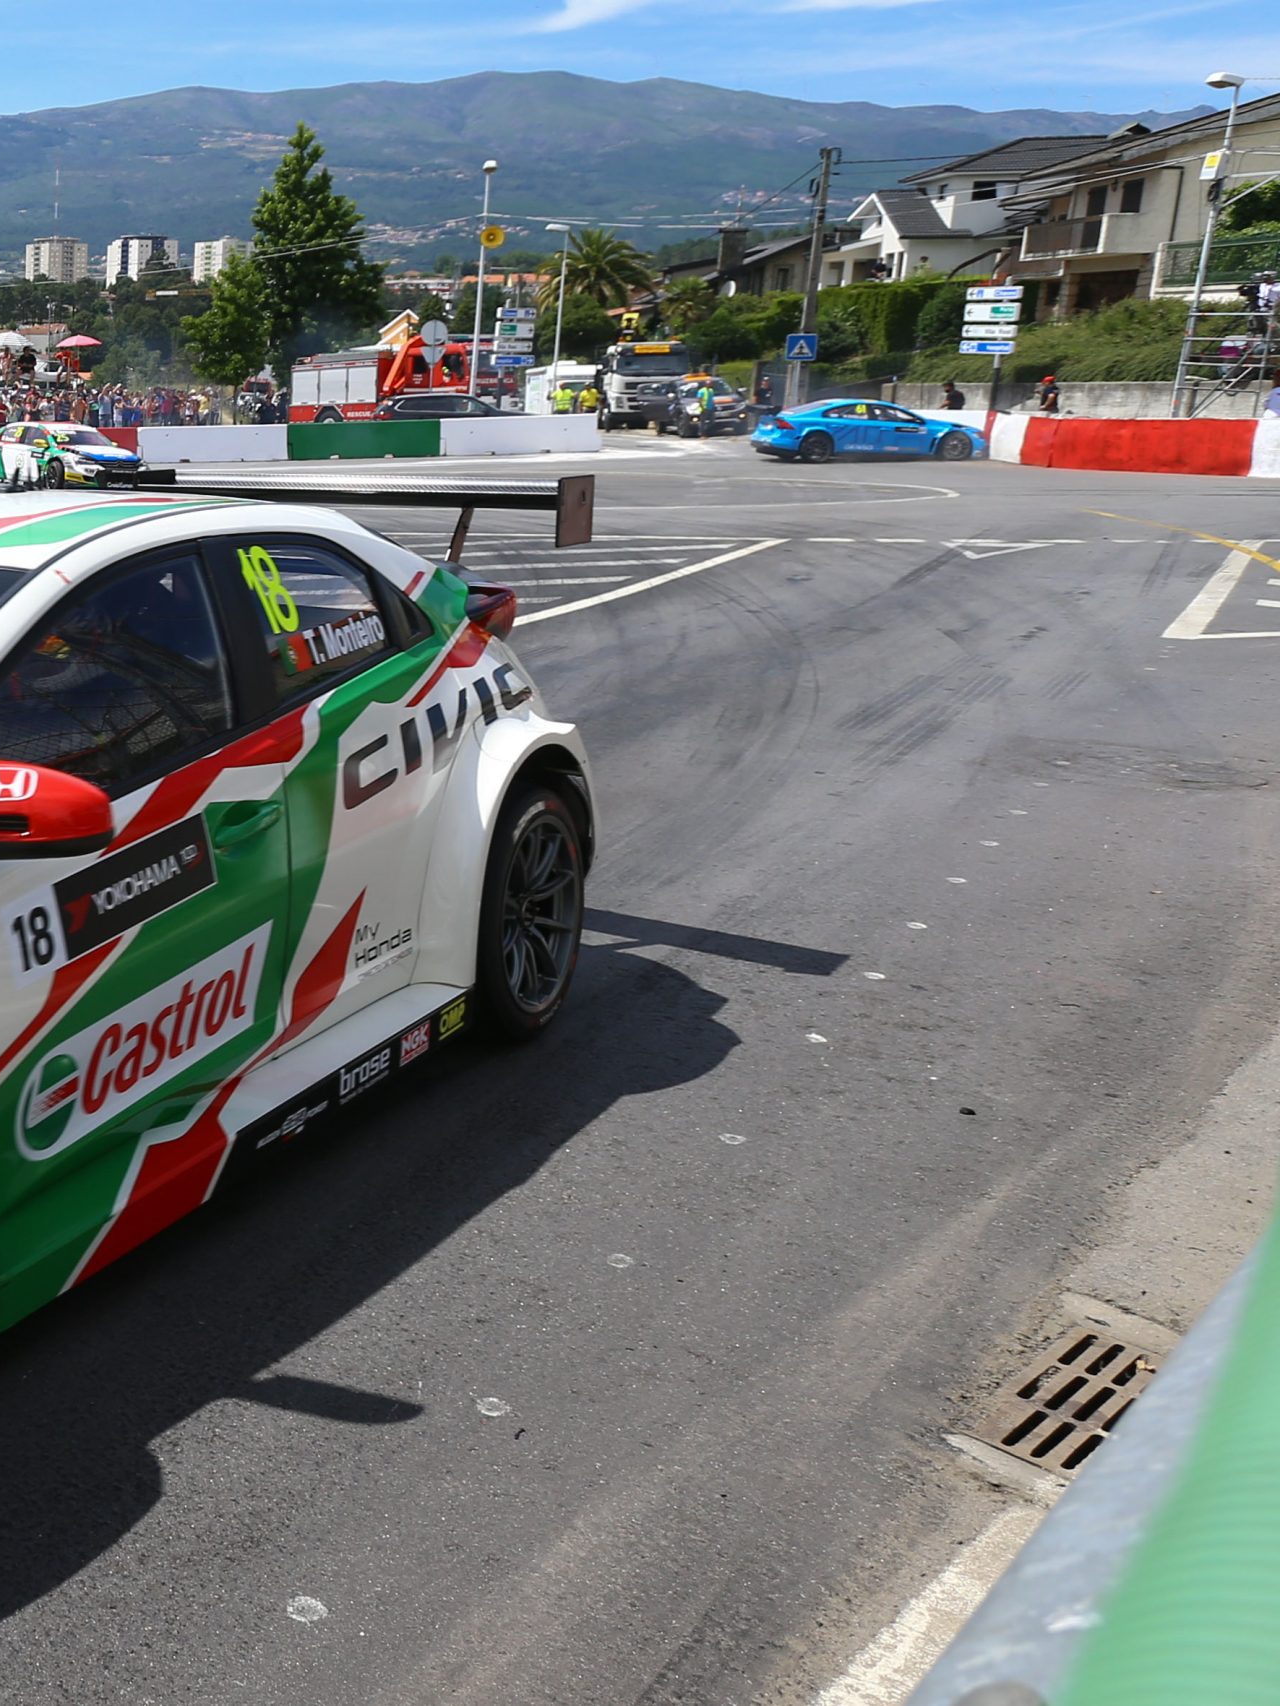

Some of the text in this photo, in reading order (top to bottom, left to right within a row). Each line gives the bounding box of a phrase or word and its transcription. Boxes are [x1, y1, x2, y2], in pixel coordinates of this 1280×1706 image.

[237, 545, 300, 634] 18
[303, 611, 386, 665] T. Monteiro
[343, 662, 533, 810] CIVIC
[90, 855, 182, 915] YOKOHAMA
[12, 905, 55, 973] 18
[354, 921, 381, 945] My
[354, 928, 412, 969] Honda
[81, 941, 257, 1116] Castrol
[400, 1023, 430, 1057] NGK
[439, 1001, 466, 1033] OMP
[339, 1047, 391, 1097] brose
